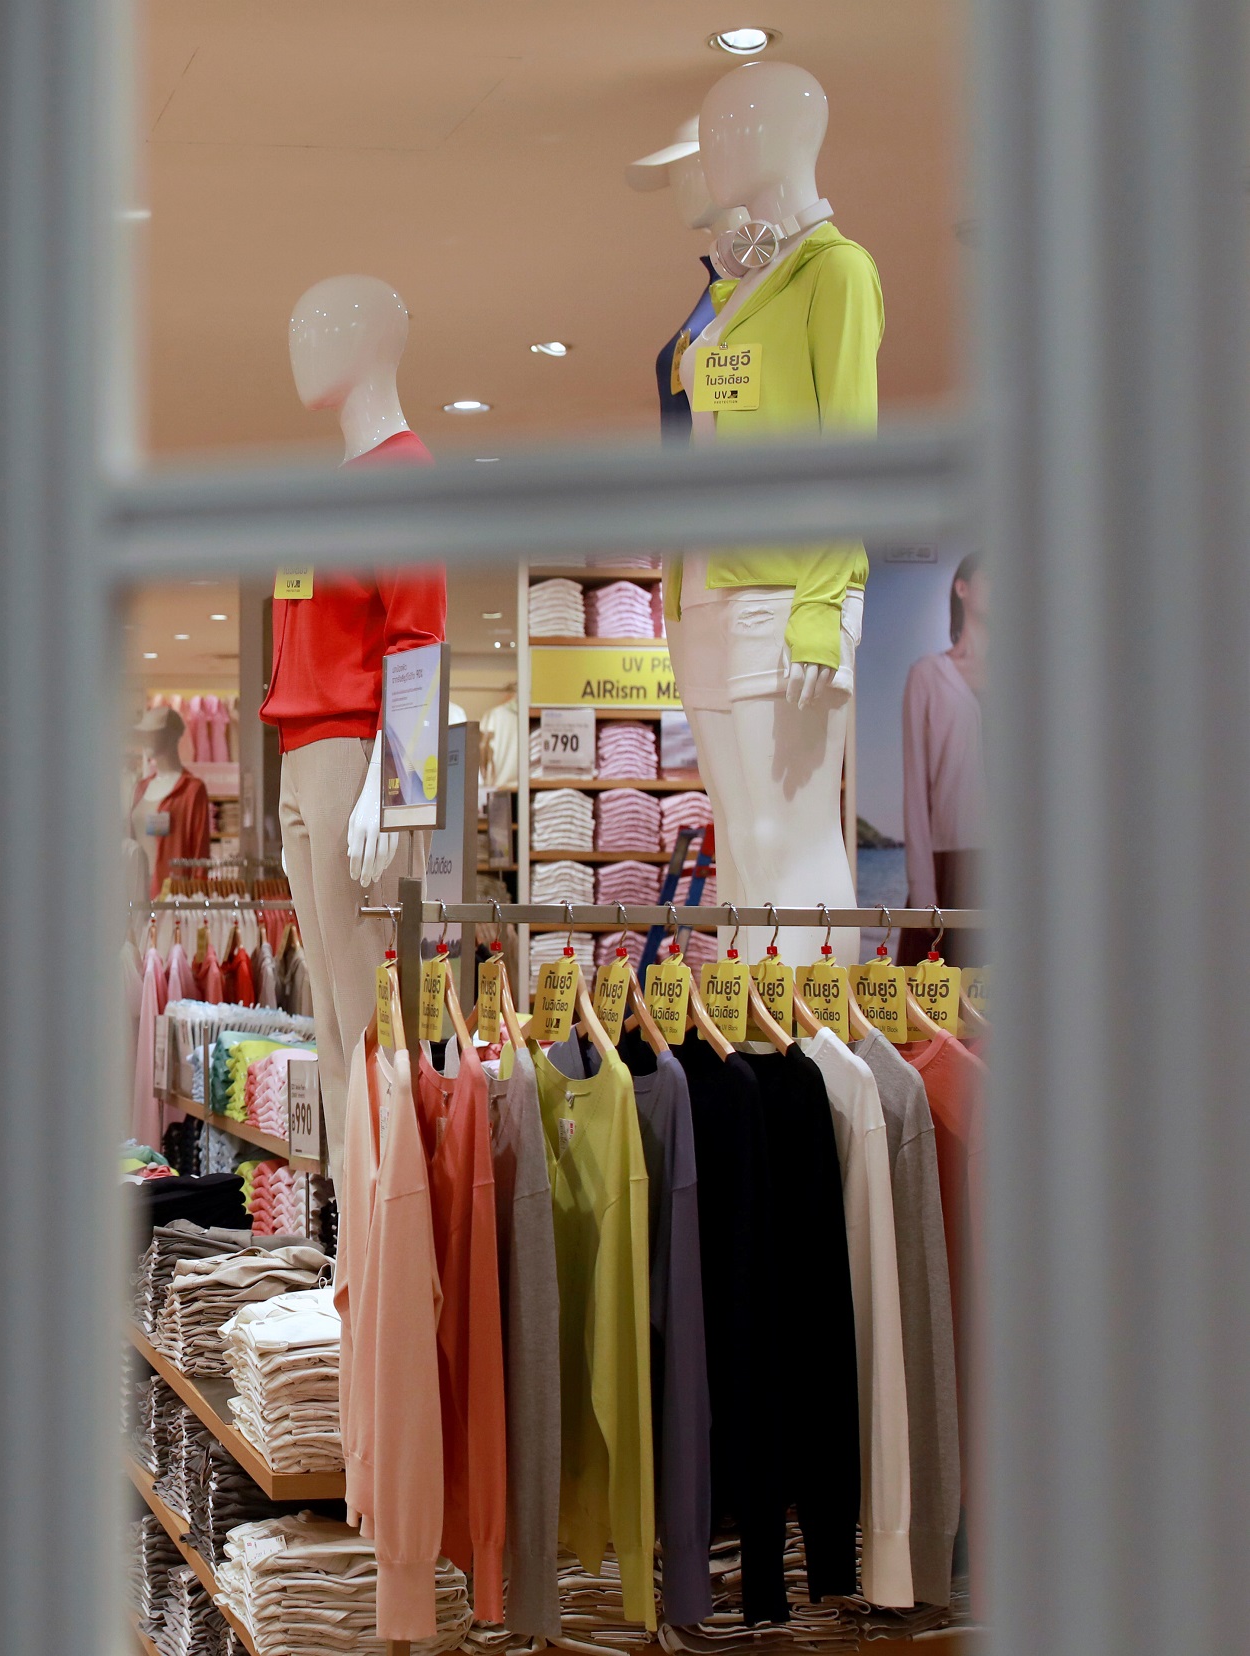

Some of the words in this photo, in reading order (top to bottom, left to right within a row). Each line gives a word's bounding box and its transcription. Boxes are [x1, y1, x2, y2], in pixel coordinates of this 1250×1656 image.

[705, 349, 751, 371] กันยูวี
[705, 373, 750, 386] ในวิเดียว
[621, 656, 644, 673] UV
[581, 680, 648, 700] AIRism
[544, 970, 574, 995] กันยูวี
[599, 977, 625, 1004] กันยูวี
[650, 976, 684, 1004] กันยูวี
[706, 974, 741, 1001] กันยูวี
[803, 977, 840, 1004] กันยูวี
[856, 976, 898, 1003] กันยูวี
